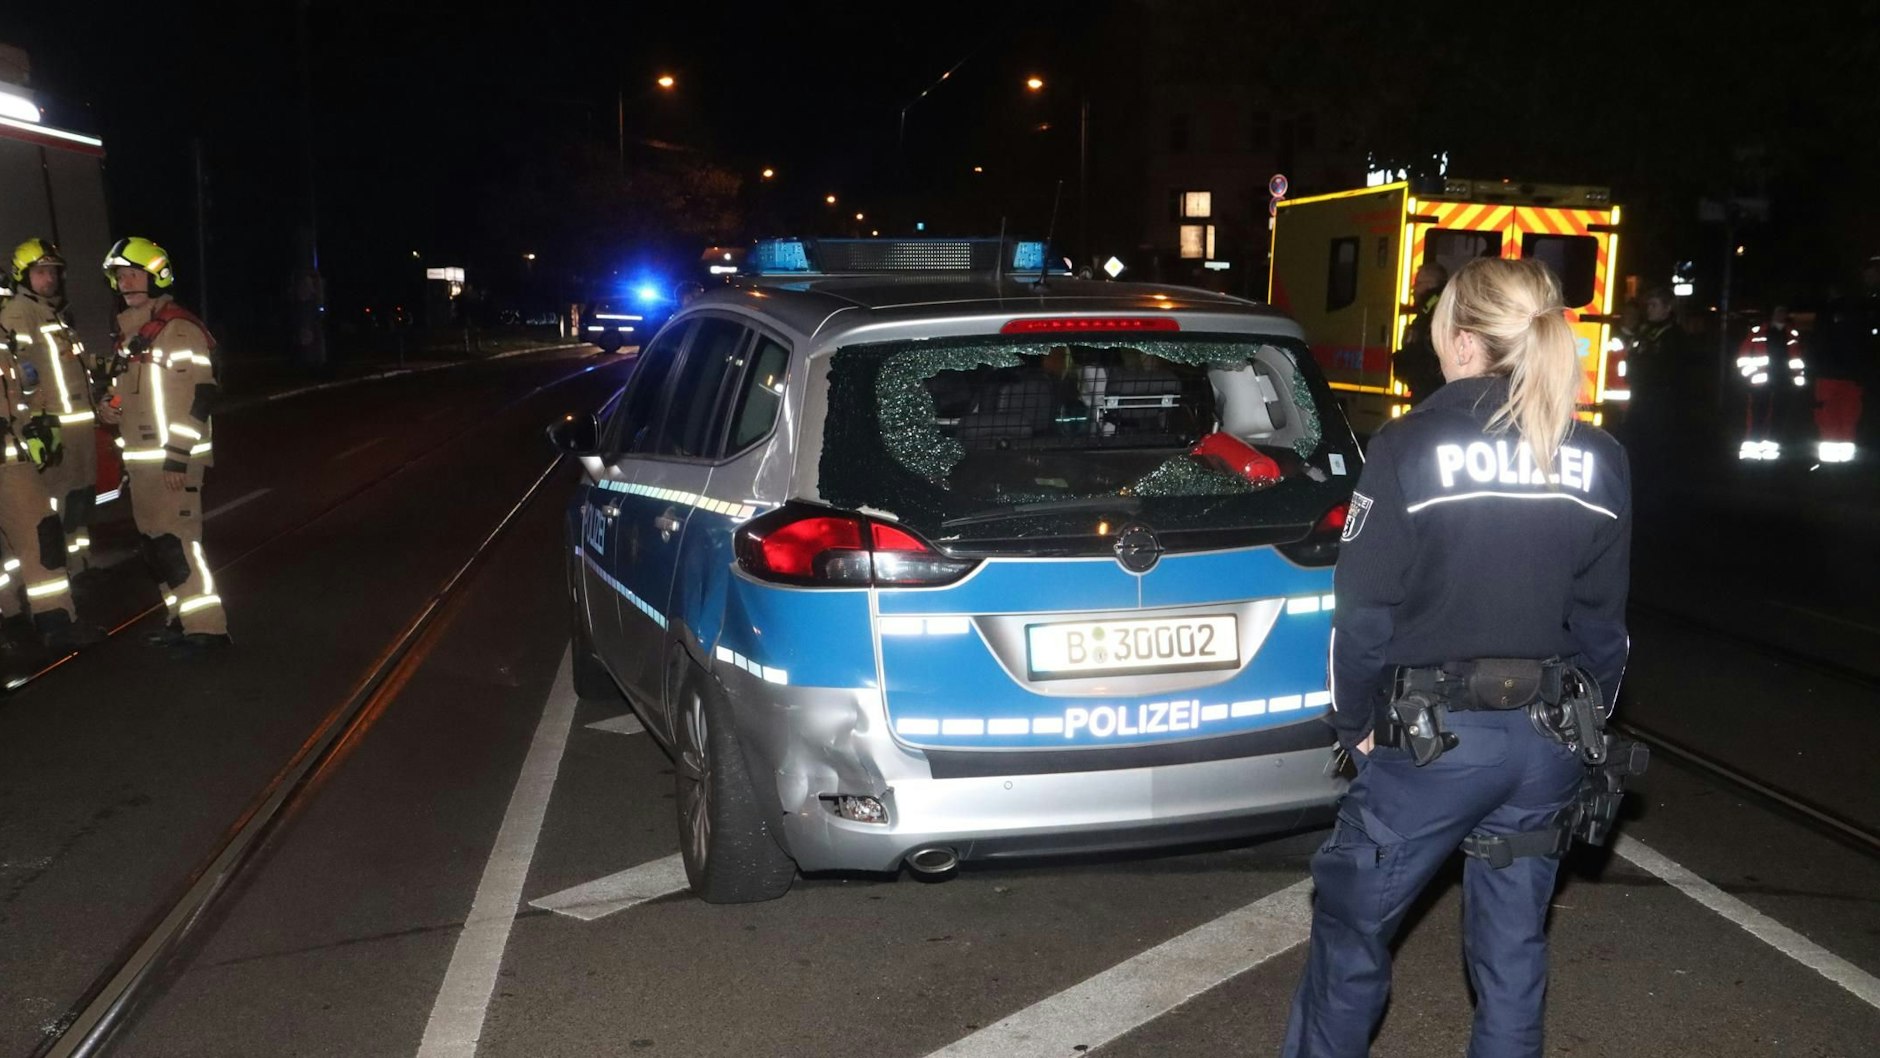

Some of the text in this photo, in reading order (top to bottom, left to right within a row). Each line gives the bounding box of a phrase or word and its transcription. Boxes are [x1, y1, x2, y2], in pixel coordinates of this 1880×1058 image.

[1067, 624, 1216, 664] B 30002
[1064, 700, 1200, 739] POLIZEI
